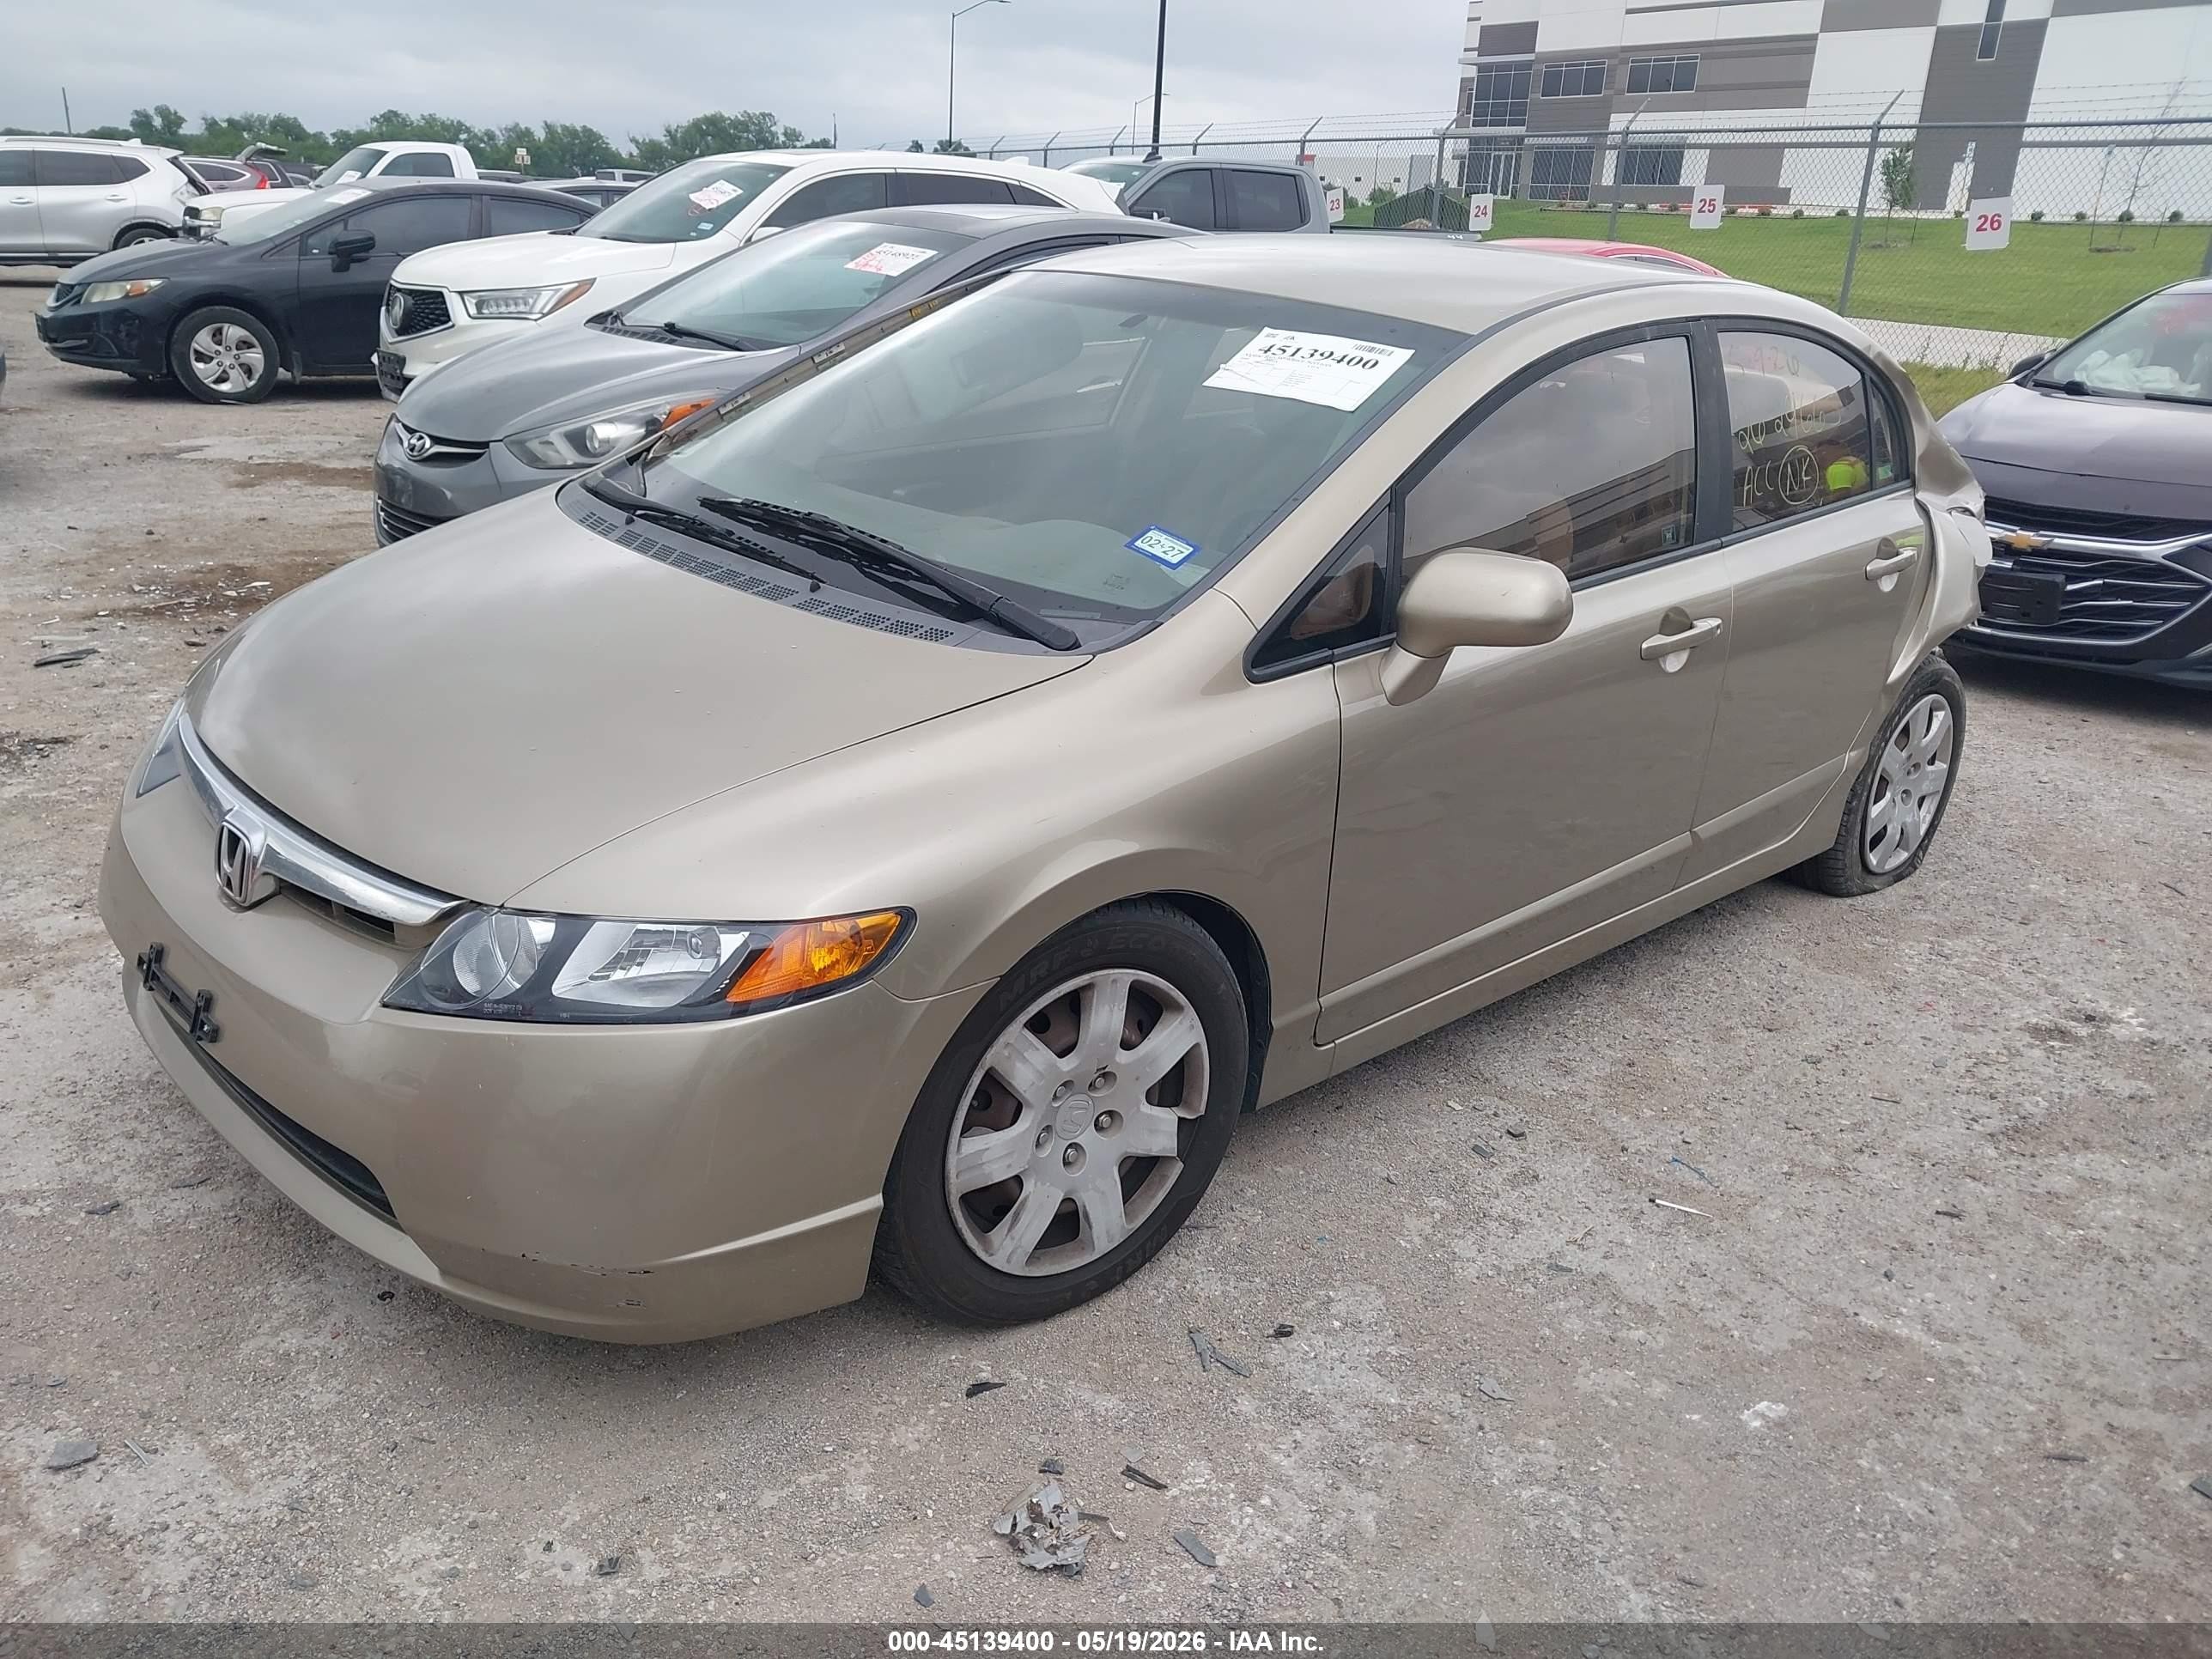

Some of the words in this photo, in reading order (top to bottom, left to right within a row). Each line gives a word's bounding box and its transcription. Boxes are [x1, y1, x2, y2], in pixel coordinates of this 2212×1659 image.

[1329, 198, 1340, 211] 23
[1474, 204, 1488, 217] 24
[1697, 198, 1717, 214] 25
[1976, 212, 2002, 232] 26
[1258, 343, 1379, 370] 45139400
[1743, 459, 1775, 507] ACC
